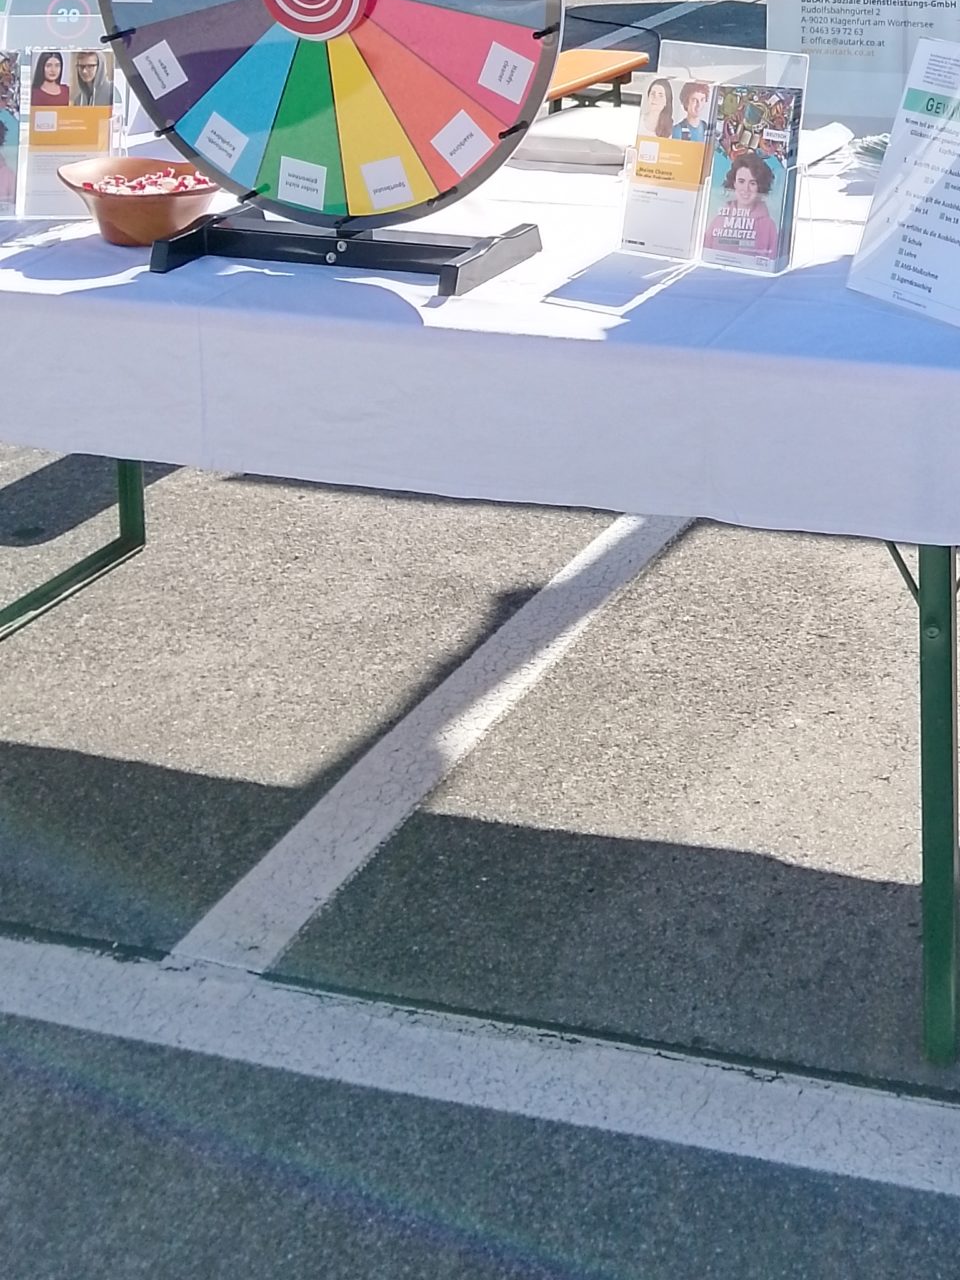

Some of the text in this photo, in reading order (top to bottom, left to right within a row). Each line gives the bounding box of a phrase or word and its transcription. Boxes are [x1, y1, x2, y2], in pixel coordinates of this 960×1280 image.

[875, 8, 881, 16] 2
[830, 17, 873, 27] Klagenfurt
[809, 27, 829, 35] 0463
[830, 28, 841, 36] 59
[842, 28, 852, 36] 72
[853, 28, 864, 36] 63
[285, 180, 319, 195] Leider nicht
[731, 208, 751, 217] DEIN
[723, 217, 755, 230] MAIN
[712, 229, 757, 239] CHARACTER
